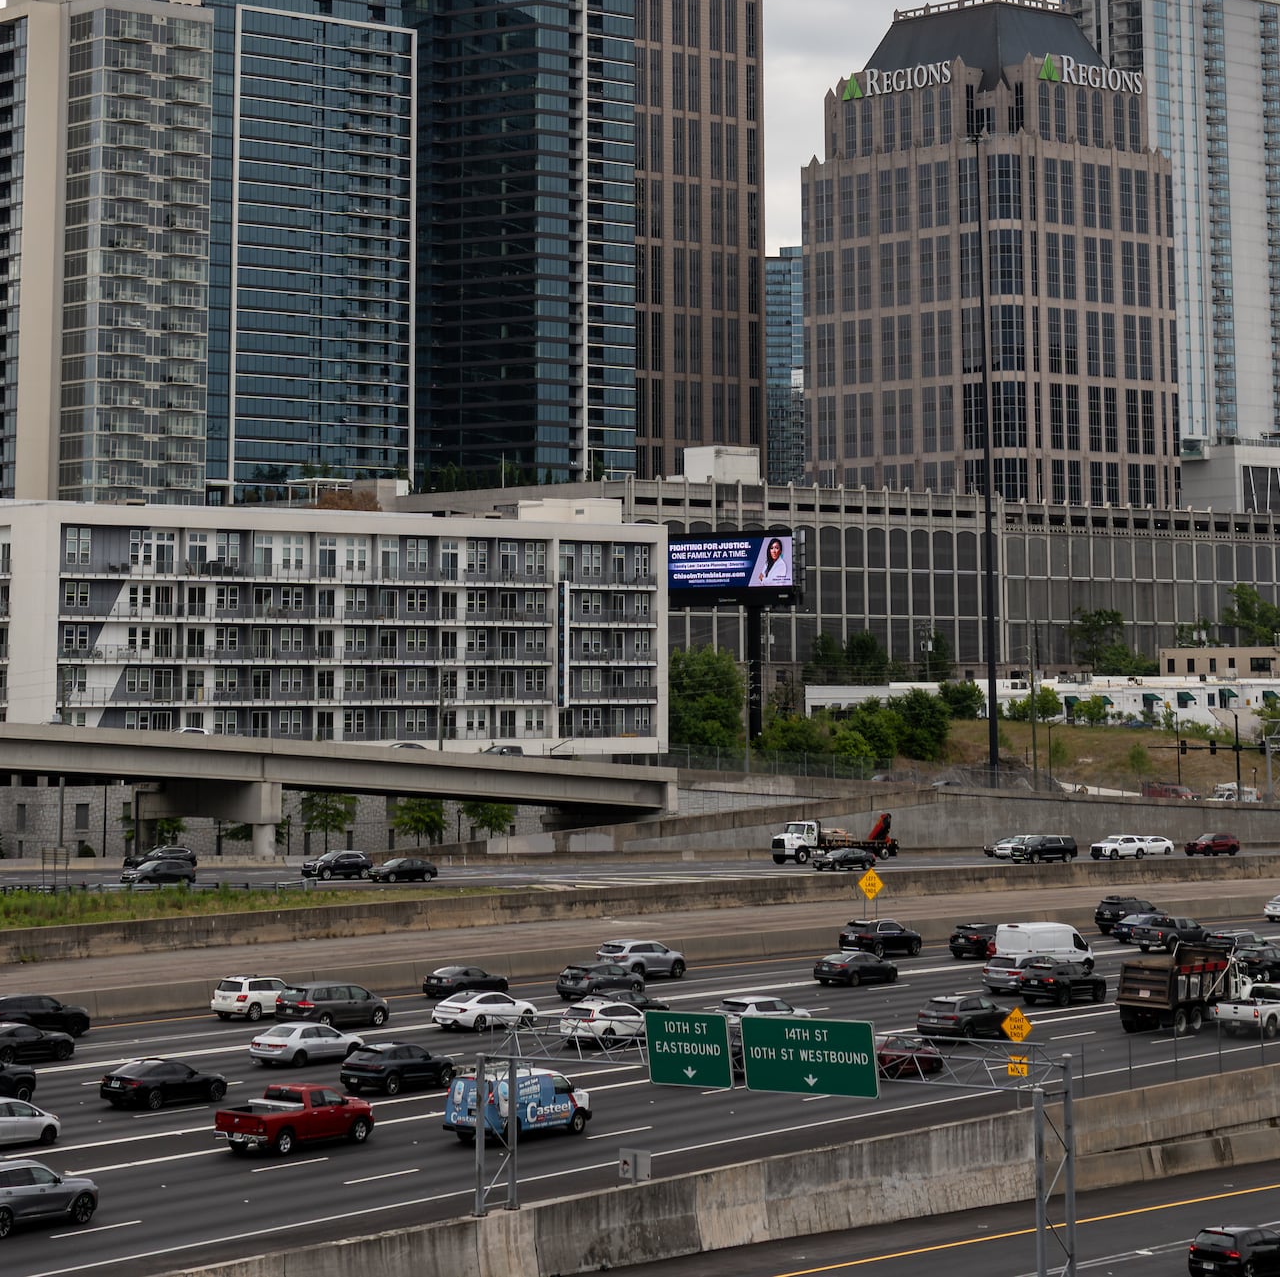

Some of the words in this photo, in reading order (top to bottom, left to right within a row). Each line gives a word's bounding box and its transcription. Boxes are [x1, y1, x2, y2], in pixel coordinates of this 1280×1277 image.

[865, 60, 952, 97] REGIONS
[1059, 54, 1143, 95] REGIONS
[669, 543, 702, 552] FIGHTING
[703, 542, 717, 551] FOR
[718, 541, 751, 550] JUSTICE.
[671, 552, 686, 560] ONE
[687, 551, 712, 559] FAMILY
[713, 550, 722, 558] AT
[723, 550, 729, 558] A
[729, 549, 748, 558] TIME.
[664, 1021, 691, 1035] 10TH
[694, 1023, 707, 1035] ST
[785, 1028, 810, 1041] 14TH
[814, 1029, 828, 1042] ST
[655, 1041, 721, 1056] EASTBOUND
[750, 1046, 776, 1060] 10TH
[780, 1048, 794, 1061] ST
[799, 1049, 869, 1066] WESTBOUND
[527, 1100, 571, 1123] Casteel
